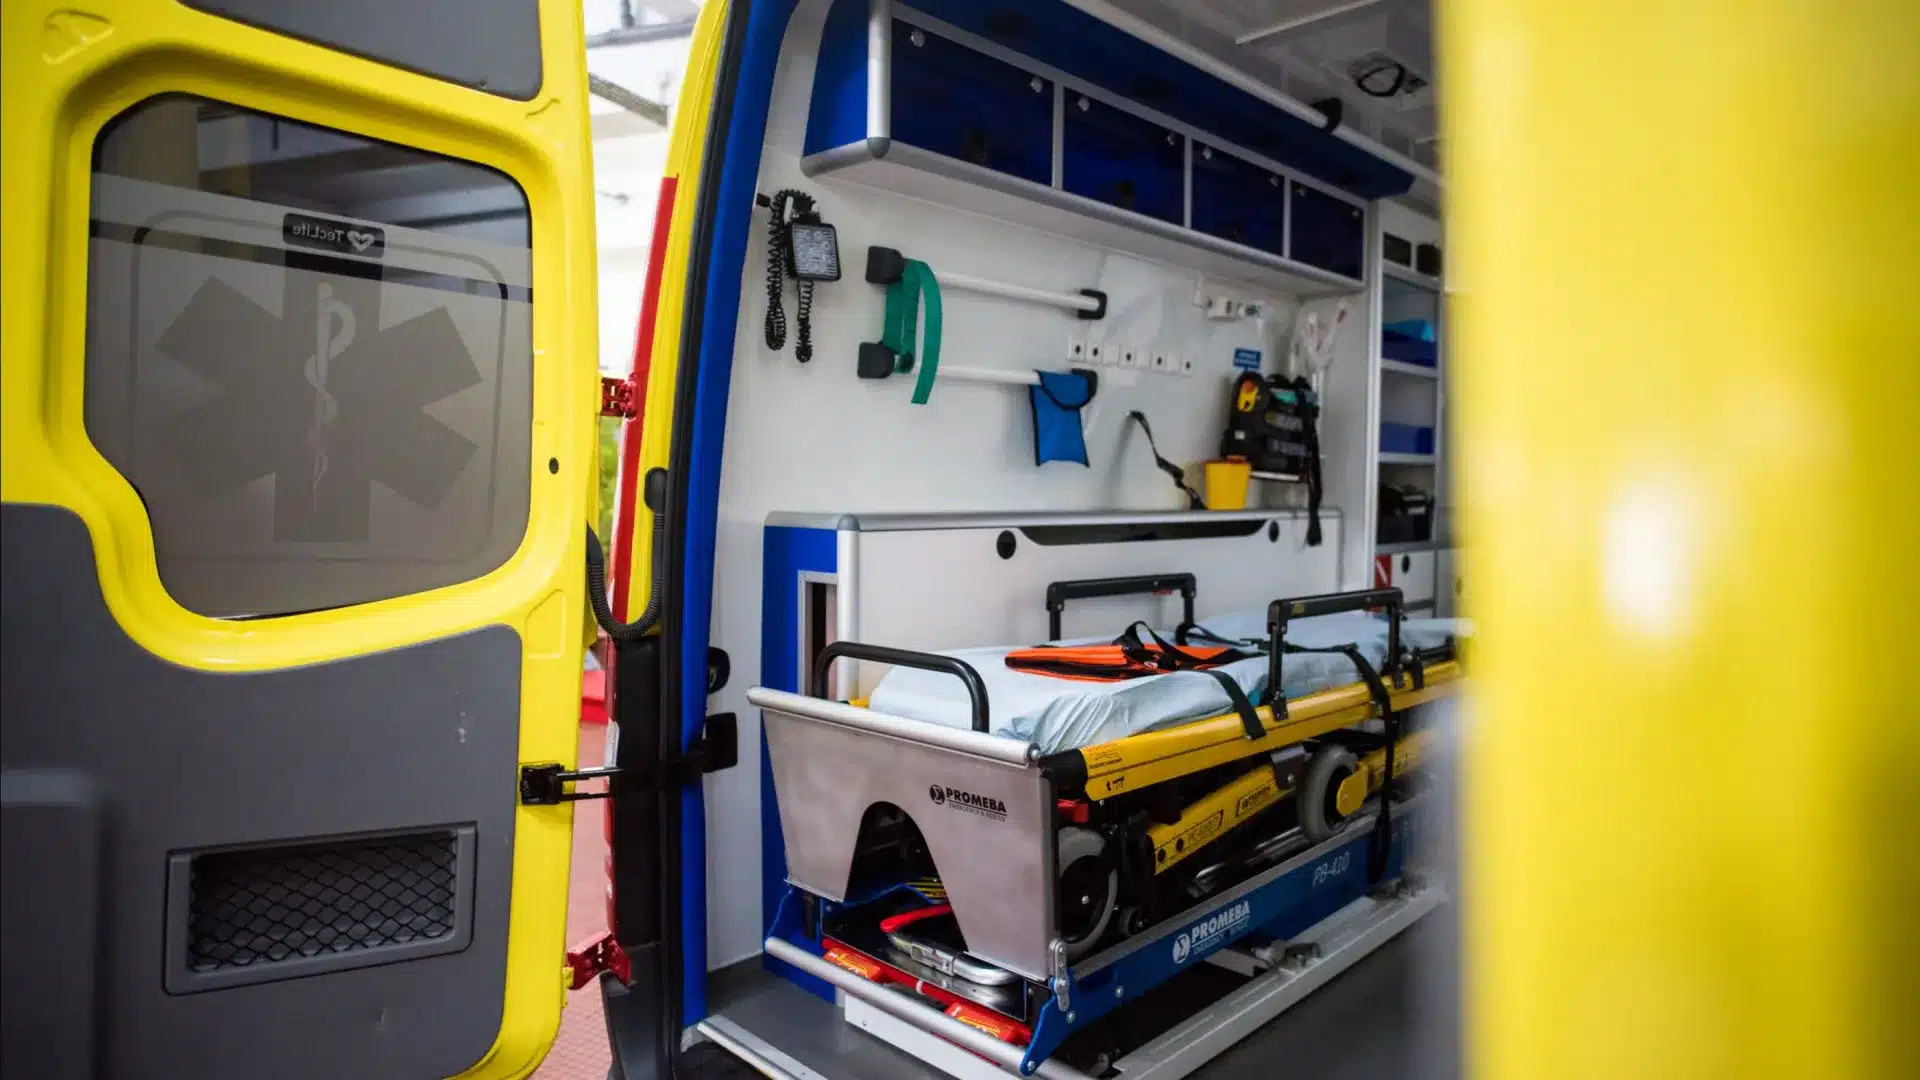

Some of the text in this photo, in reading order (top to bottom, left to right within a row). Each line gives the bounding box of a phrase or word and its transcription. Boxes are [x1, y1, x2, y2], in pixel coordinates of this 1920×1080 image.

[945, 787, 1007, 813] PROMEBA
[1312, 851, 1351, 888] PB-410
[1191, 900, 1250, 943] PROMEBA
